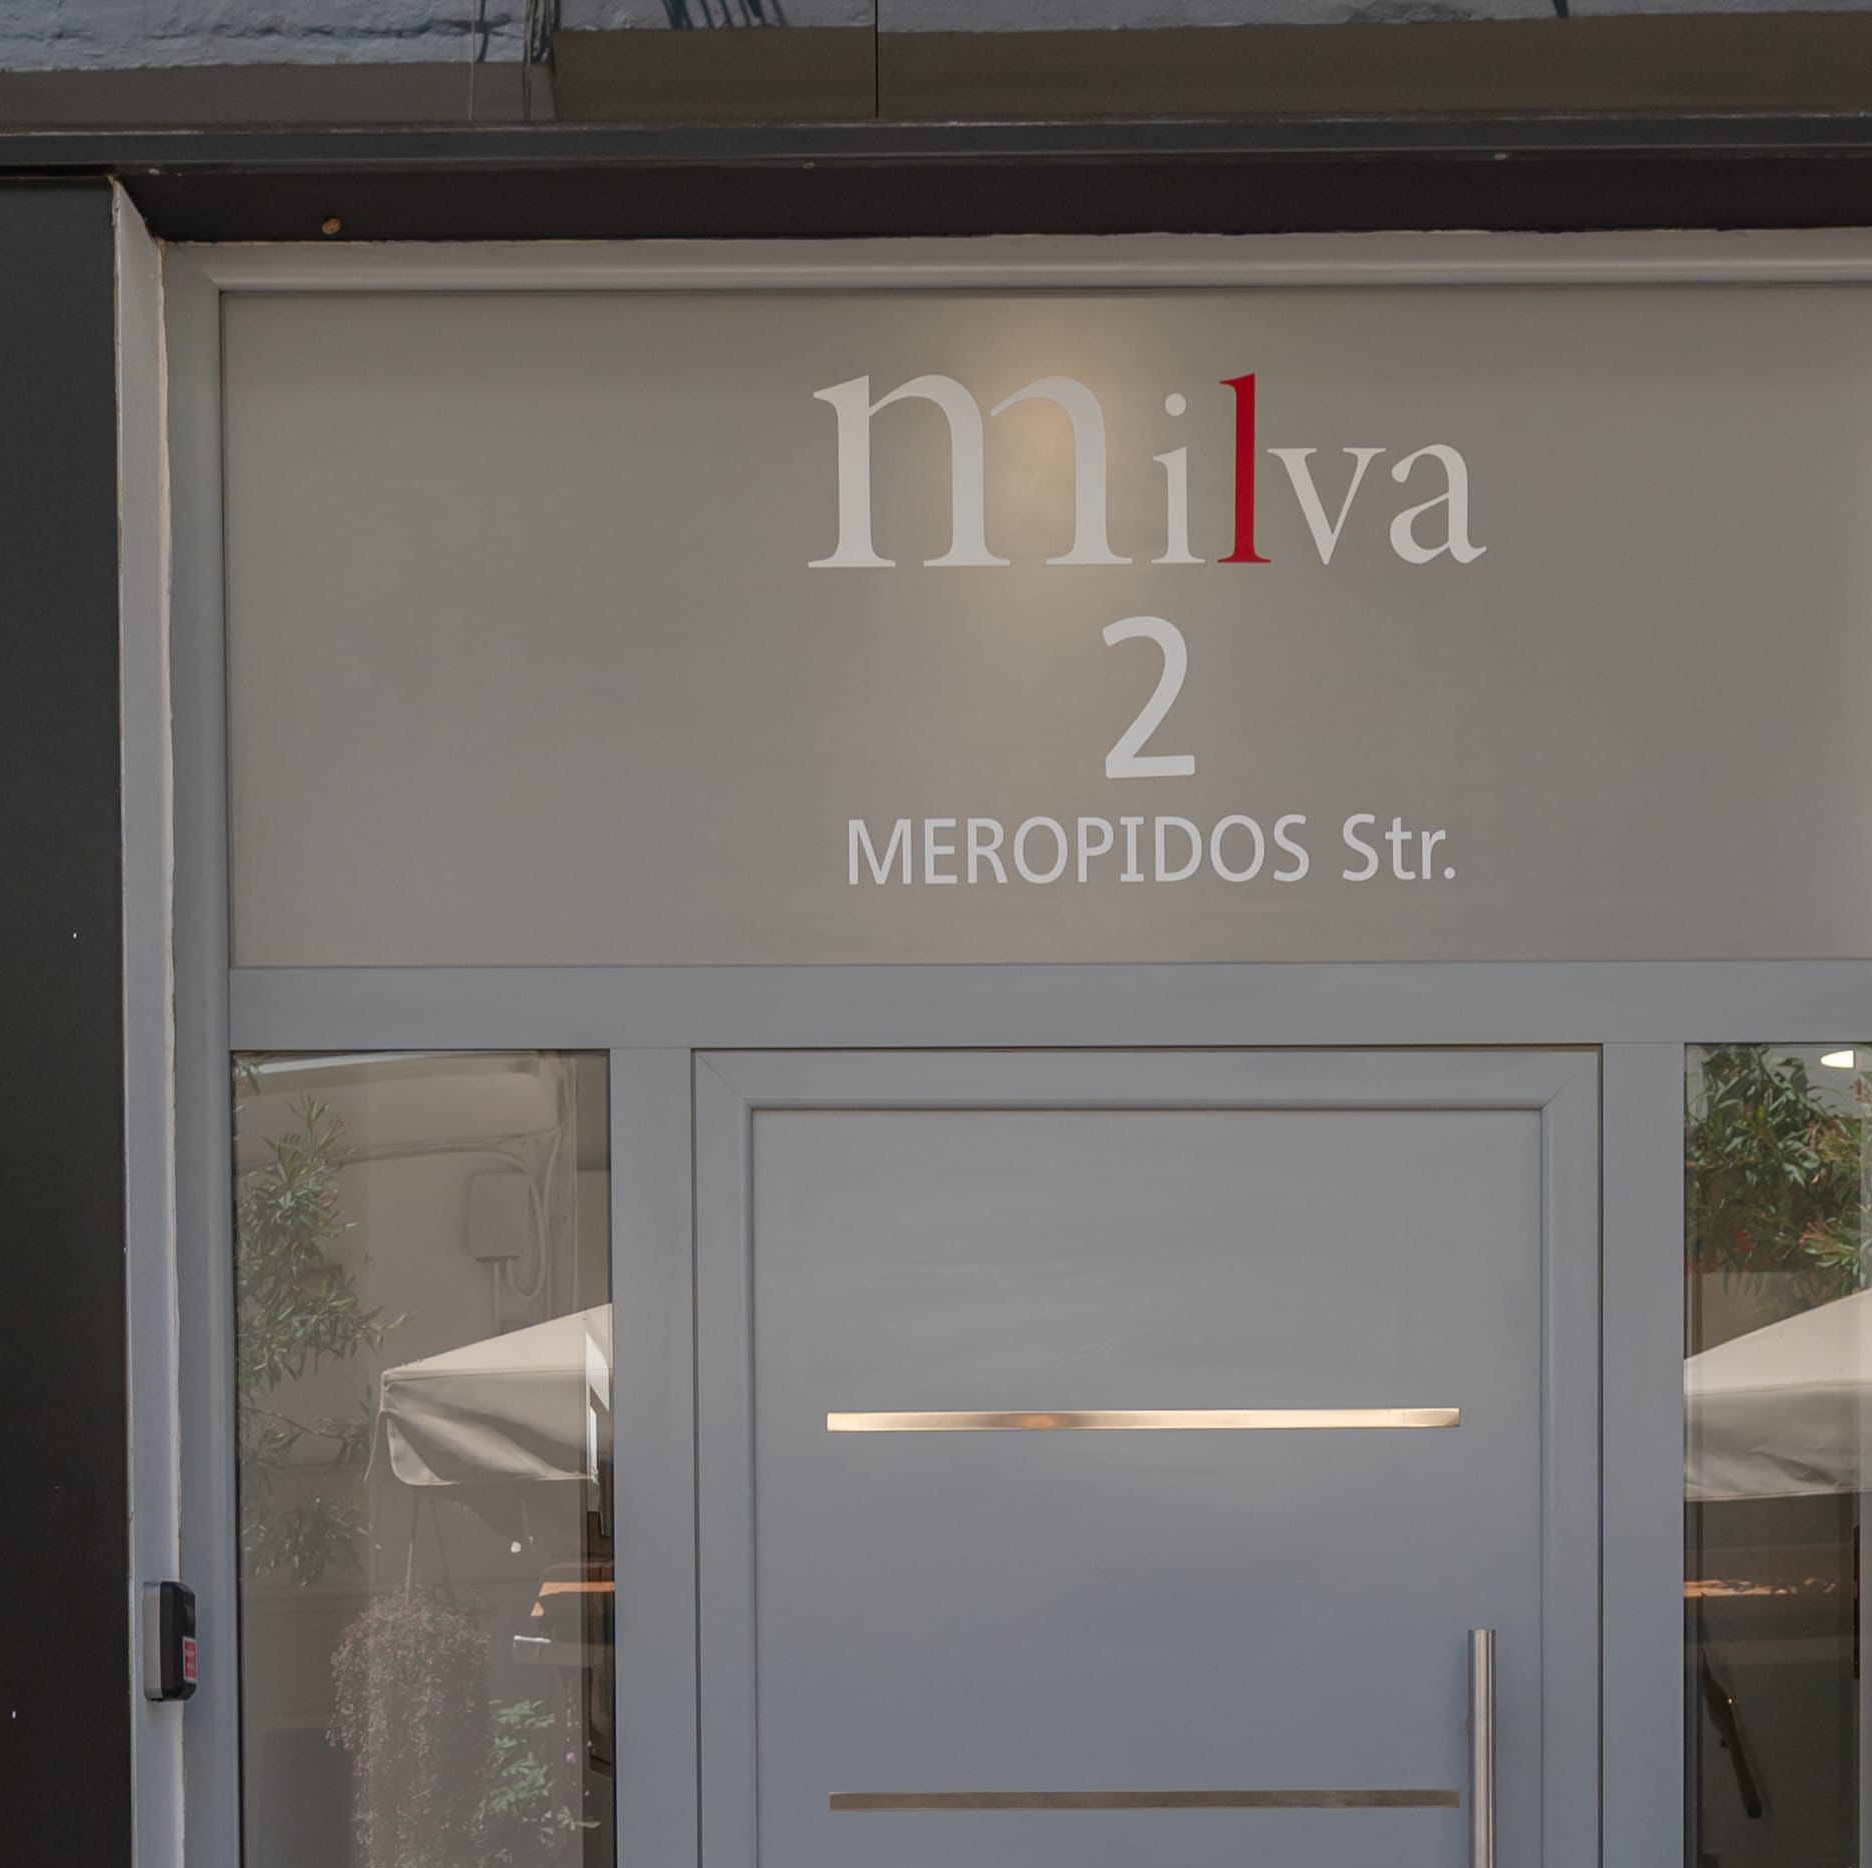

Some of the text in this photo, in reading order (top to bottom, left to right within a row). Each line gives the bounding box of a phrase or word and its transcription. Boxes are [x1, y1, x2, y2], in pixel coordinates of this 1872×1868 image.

[807, 371, 1487, 569] milva
[1101, 615, 1196, 780] 2
[847, 812, 1458, 887] MEROPIDOS Str.
